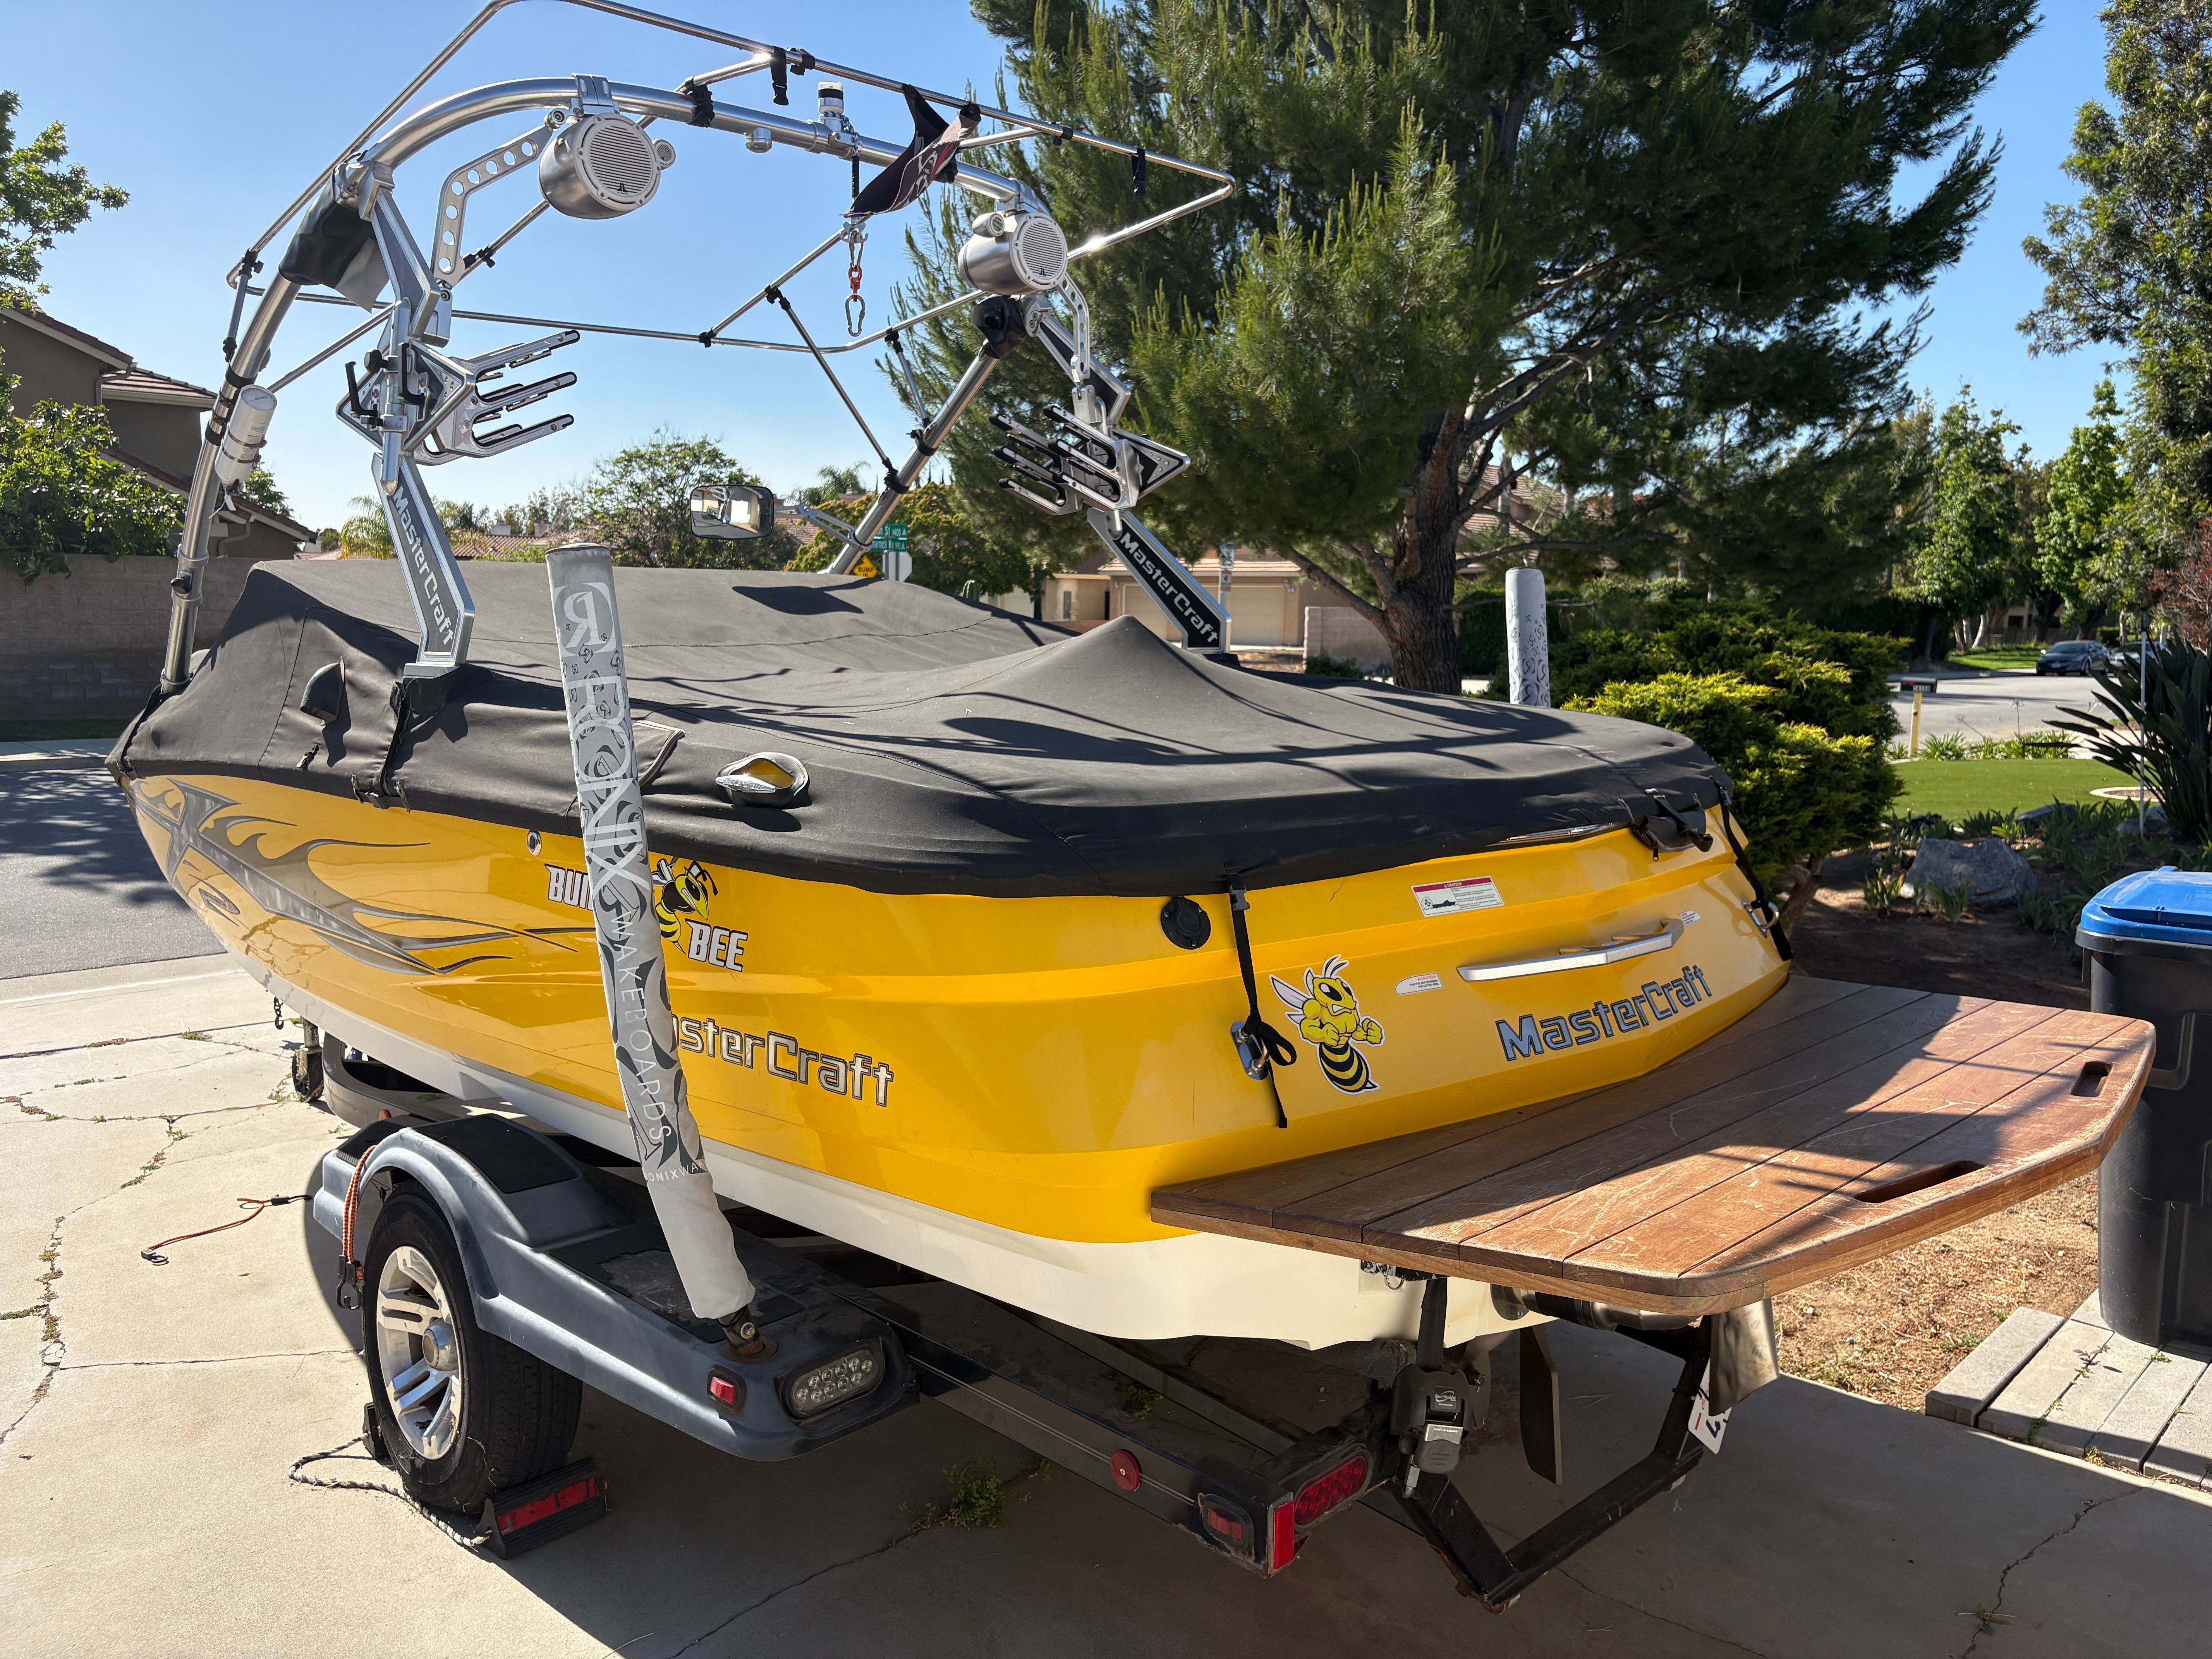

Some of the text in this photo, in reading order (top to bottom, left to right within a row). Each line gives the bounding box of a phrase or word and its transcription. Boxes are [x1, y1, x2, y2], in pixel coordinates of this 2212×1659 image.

[393, 485, 453, 645] MasterCraft
[1120, 532, 1218, 643] MasterCraft
[685, 918, 748, 972] BEE
[611, 911, 672, 1140] WAKEBOARDS
[672, 1013, 894, 1108] sterCraft
[1495, 965, 1712, 1061] MasterCraft
